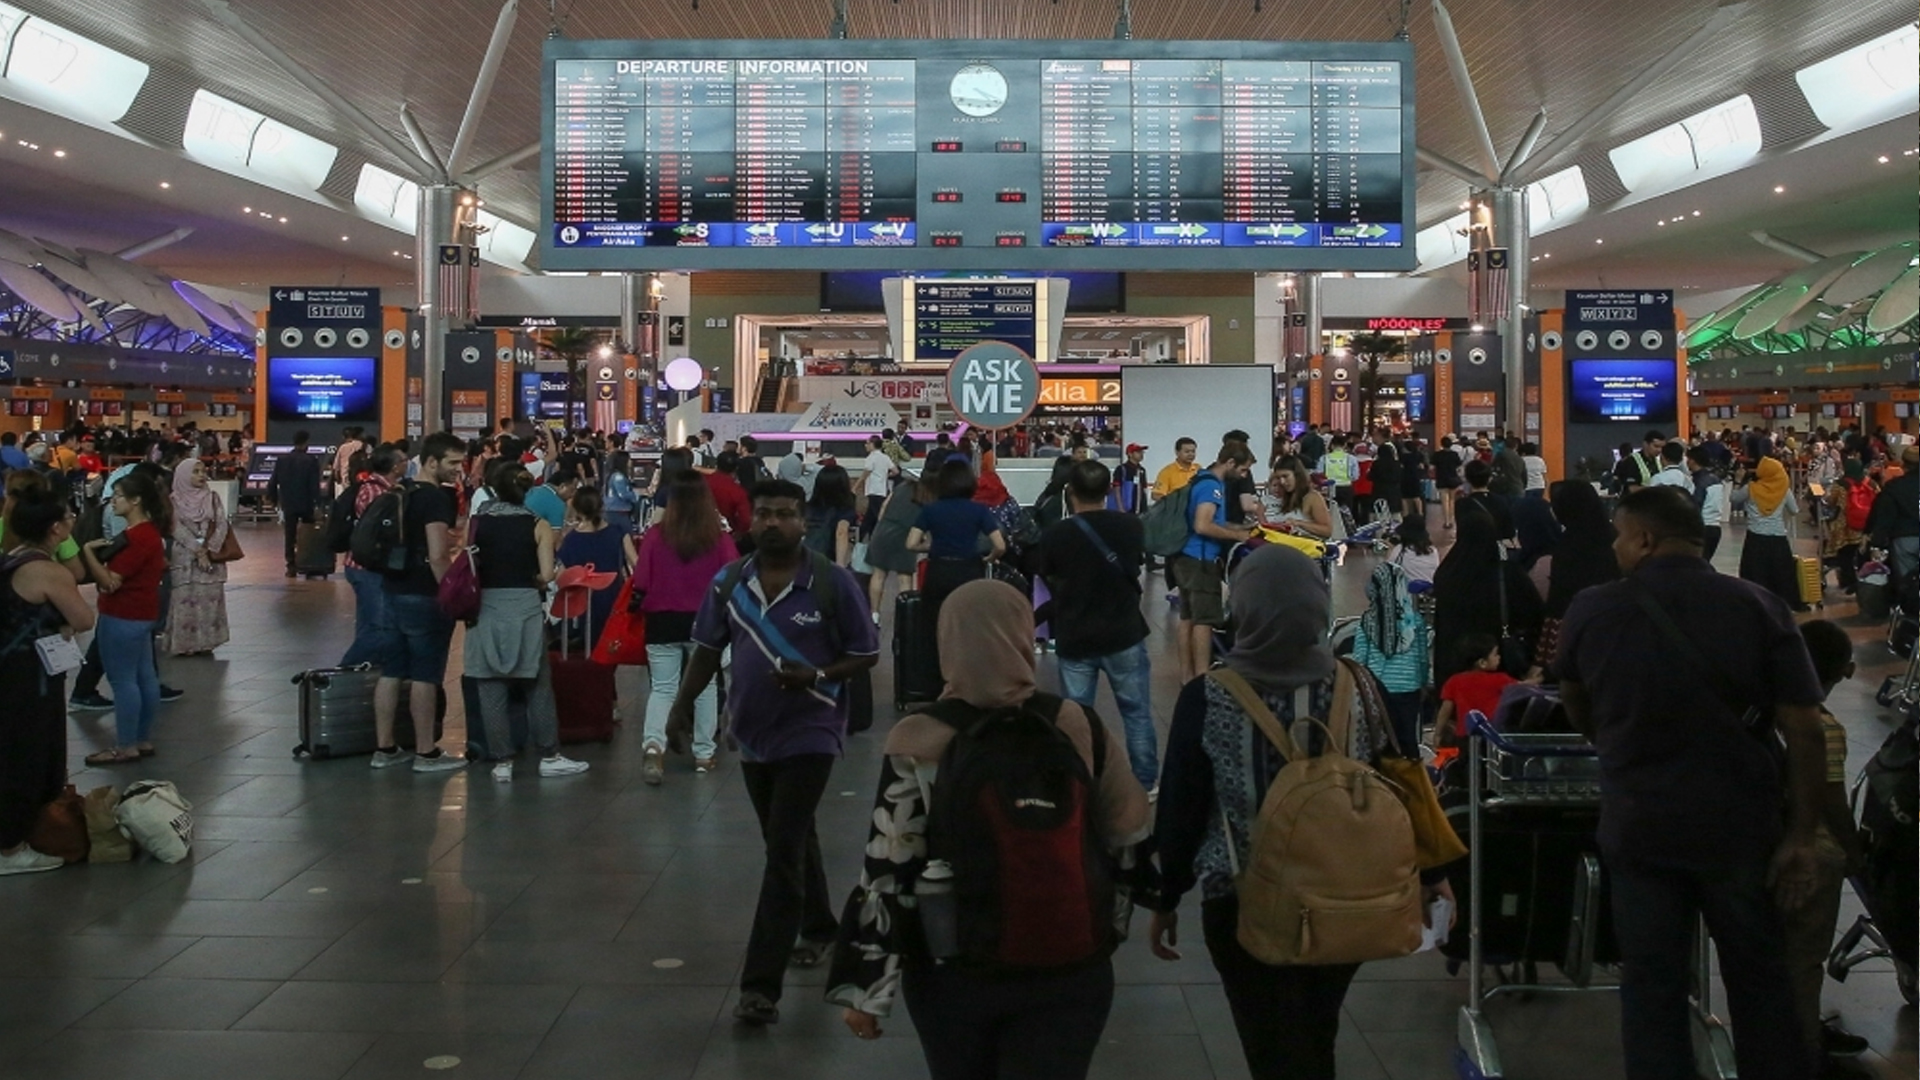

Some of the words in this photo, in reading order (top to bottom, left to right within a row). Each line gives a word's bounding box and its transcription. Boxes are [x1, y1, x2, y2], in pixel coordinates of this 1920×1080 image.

[616, 60, 728, 74] DEPARTURE
[739, 60, 868, 74] INFORMATION
[696, 223, 709, 237] S
[766, 222, 779, 236] T
[830, 222, 844, 236] U
[892, 222, 906, 236] V
[1091, 223, 1110, 237] W
[1179, 223, 1193, 237] X
[1270, 223, 1283, 237] Y
[1355, 223, 1369, 238] Z
[602, 237, 635, 246] AirAsia
[963, 359, 1023, 382] ASK
[962, 383, 1023, 413] ME
[1038, 382, 1087, 401] klia
[1102, 382, 1120, 401] 2
[829, 417, 887, 428] AIRPORTS
